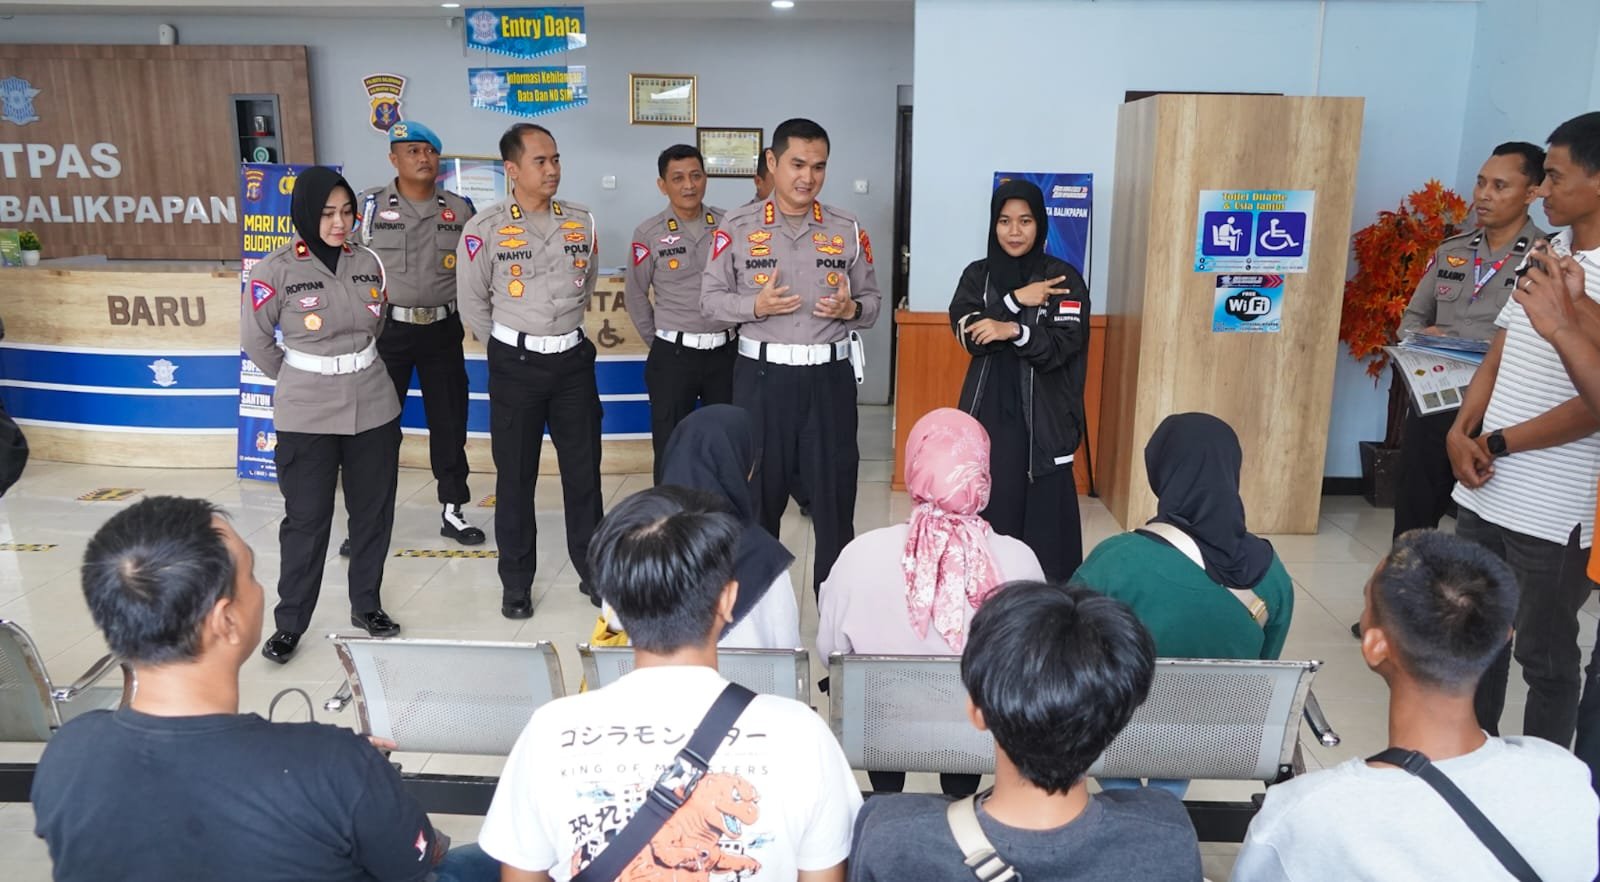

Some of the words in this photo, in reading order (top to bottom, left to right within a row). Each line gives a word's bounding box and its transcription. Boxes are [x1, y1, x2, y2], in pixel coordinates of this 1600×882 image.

[501, 15, 541, 39] Entry
[544, 14, 580, 37] Data
[506, 72, 540, 84] Informasi
[517, 90, 534, 102] Data
[534, 89, 548, 102] Dan
[0, 143, 122, 179] TPAS
[0, 195, 238, 225] BALIKPAPAN
[1053, 206, 1088, 218] BALIKPAPAN
[243, 214, 275, 233] MARI
[497, 250, 532, 261] WAHYU
[745, 258, 778, 270] SONNY
[816, 258, 847, 269] POLRI
[107, 295, 206, 327] BARU
[560, 763, 602, 777] KING
[616, 763, 641, 774] OF
